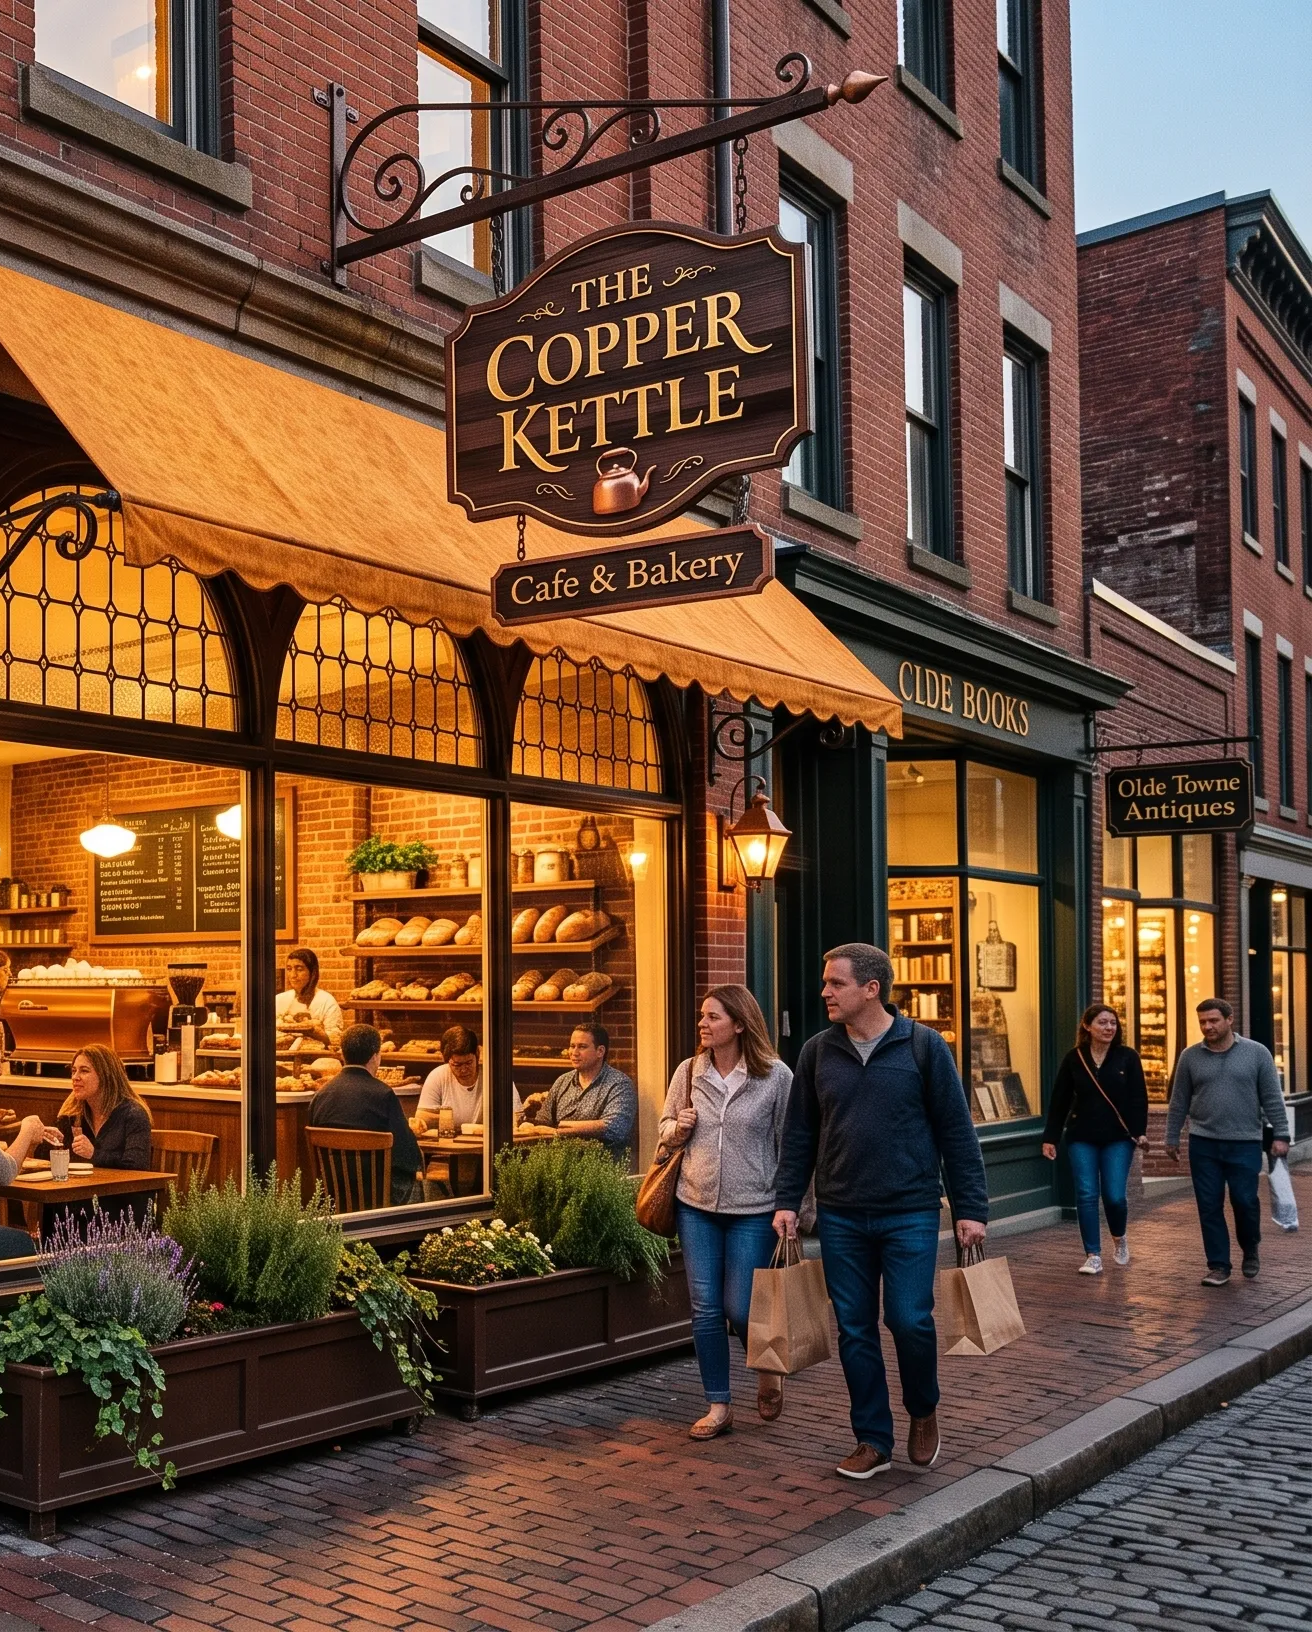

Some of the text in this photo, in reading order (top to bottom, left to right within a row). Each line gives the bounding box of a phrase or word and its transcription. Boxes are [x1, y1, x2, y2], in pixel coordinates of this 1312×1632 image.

[571, 263, 653, 313] THE
[486, 291, 773, 402] COPPER
[496, 364, 744, 474] KETTLE
[511, 551, 744, 605] Cafe & Bakery
[962, 681, 1029, 736] BOOKS
[1118, 774, 1240, 798] Olde Towne
[1124, 799, 1236, 823] Antiques
